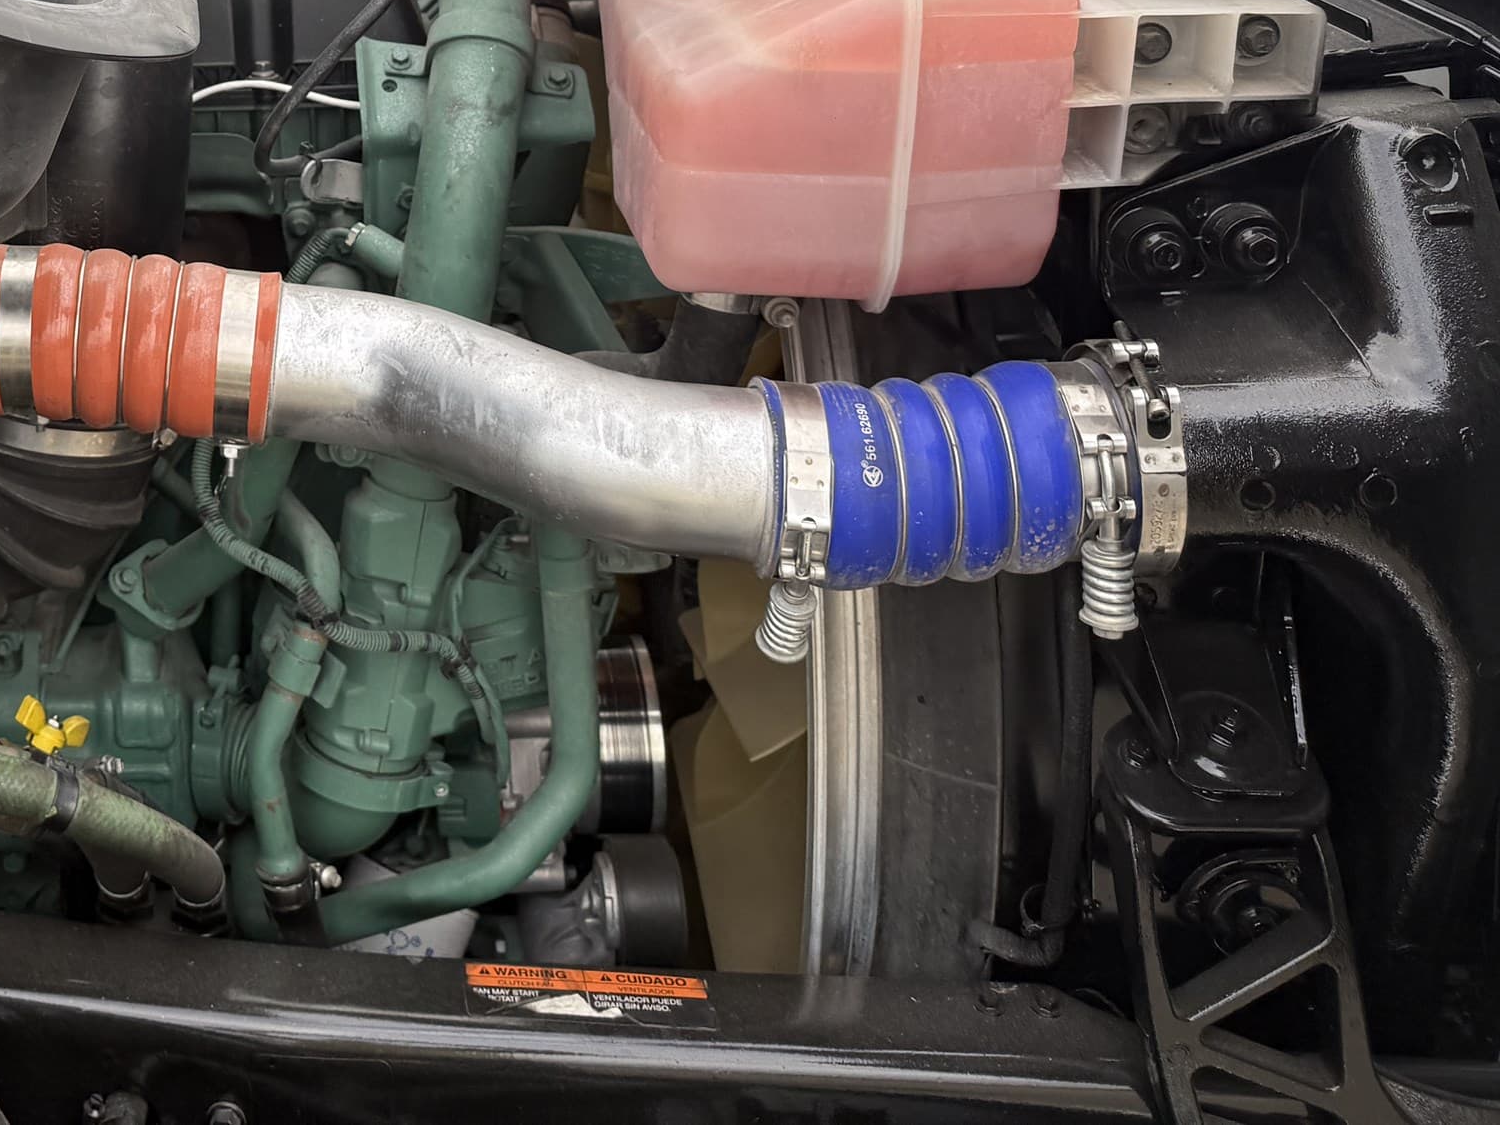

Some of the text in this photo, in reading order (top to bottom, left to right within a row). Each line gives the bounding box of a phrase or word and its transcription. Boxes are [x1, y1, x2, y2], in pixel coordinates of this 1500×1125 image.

[854, 403, 877, 461] 561.62690
[493, 966, 567, 979] WARNING
[498, 979, 536, 987] CLUTCH
[616, 974, 687, 986] CUIDADO
[491, 987, 510, 996] MAY
[512, 989, 539, 997] START
[619, 986, 675, 995] VENTILADOR
[592, 994, 683, 1006] VENTILADOR PUEDE
[625, 1002, 640, 1010] SIN
[642, 1003, 671, 1012] AVISO.
